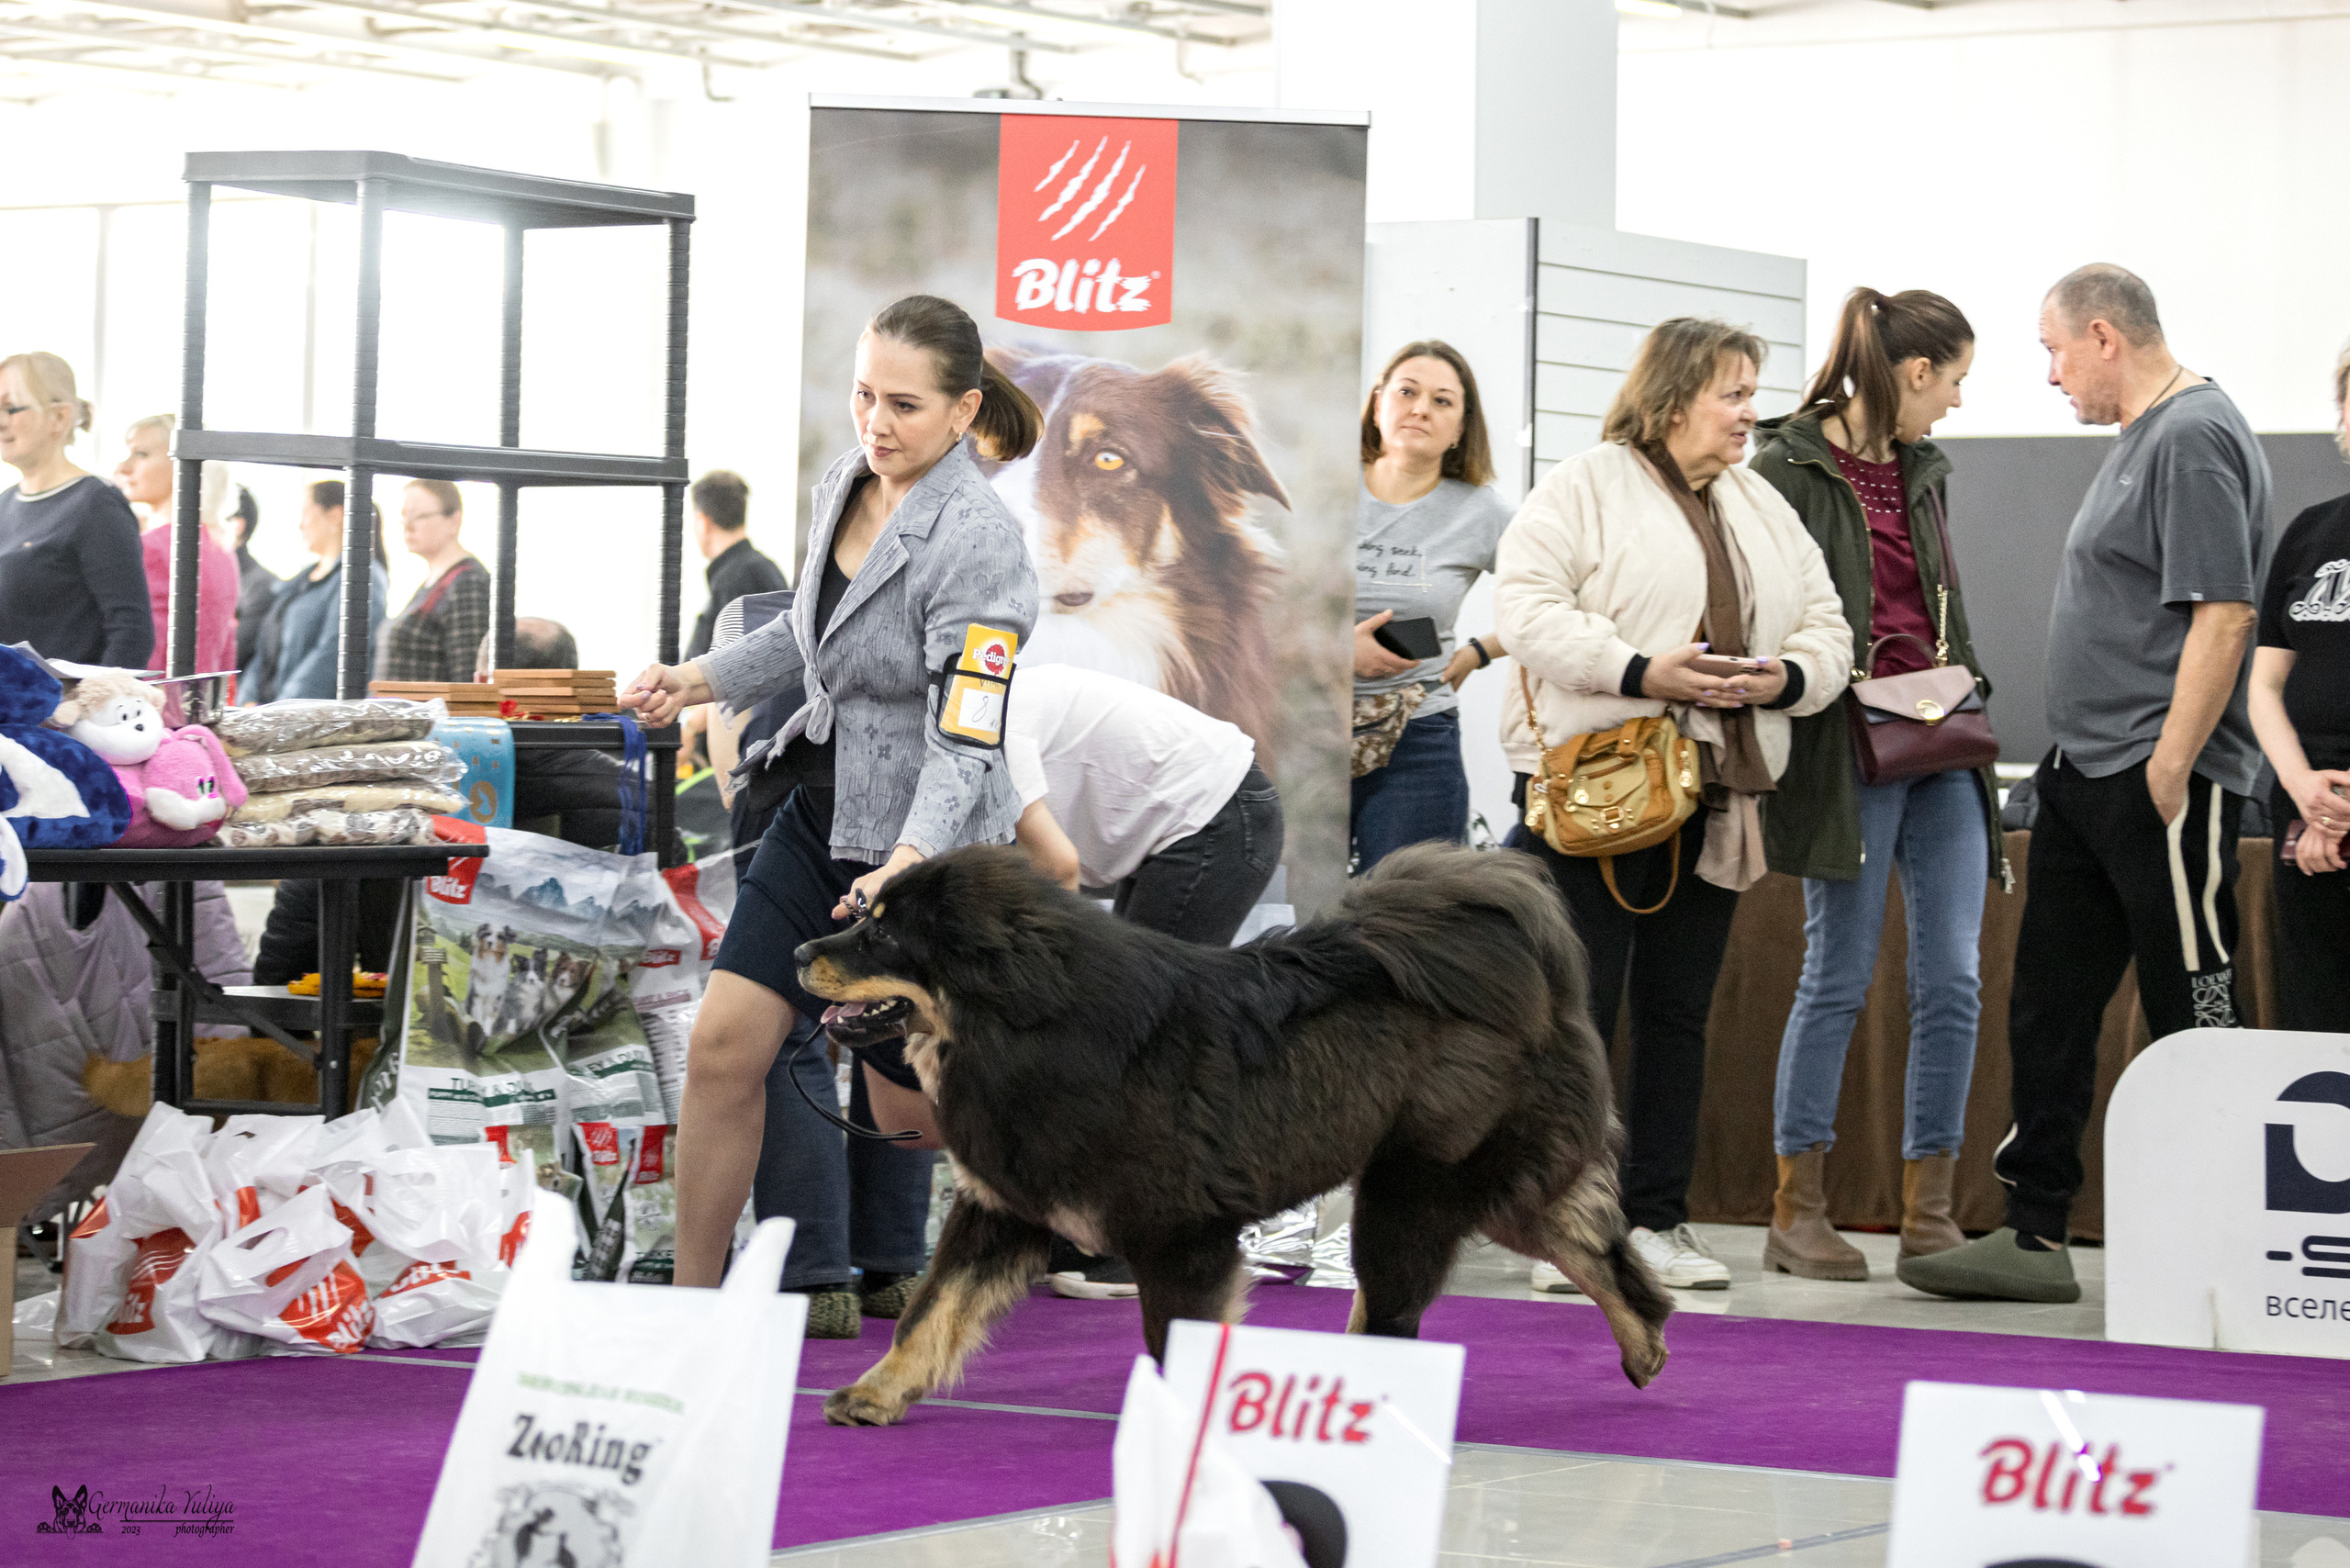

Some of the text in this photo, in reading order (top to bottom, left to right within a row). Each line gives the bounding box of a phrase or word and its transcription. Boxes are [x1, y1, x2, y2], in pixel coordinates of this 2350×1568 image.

[1012, 257, 1153, 314] Blitz
[1227, 1370, 1375, 1444] Blitz
[507, 1413, 653, 1486] ZooRing
[1978, 1436, 2159, 1517] Blitz
